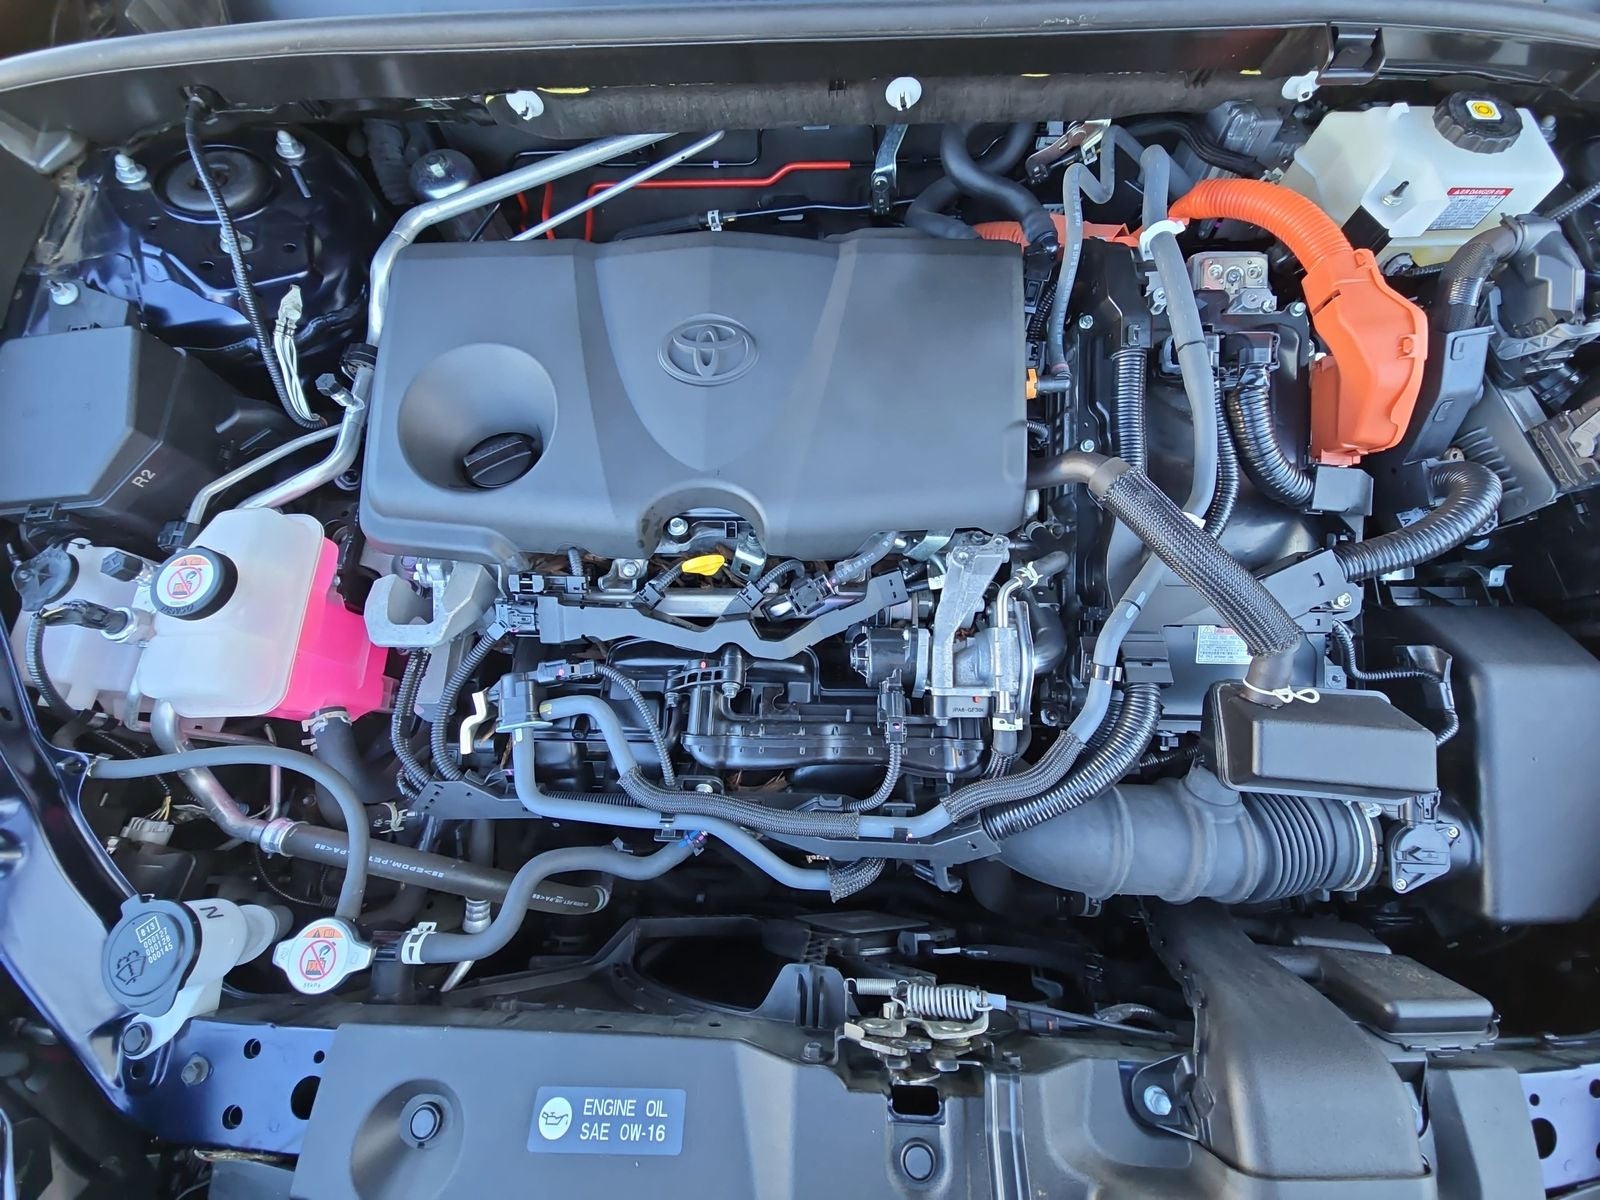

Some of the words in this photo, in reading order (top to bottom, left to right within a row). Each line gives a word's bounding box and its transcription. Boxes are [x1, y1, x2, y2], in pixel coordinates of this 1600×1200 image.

[131, 469, 156, 488] R2
[143, 927, 169, 949] 000127
[145, 937, 171, 956] 000128
[148, 943, 174, 964] 000145
[583, 1098, 637, 1117] ENGINE
[645, 1100, 668, 1118] OIL
[580, 1122, 611, 1141] SAE
[619, 1123, 666, 1142] 0W-16
